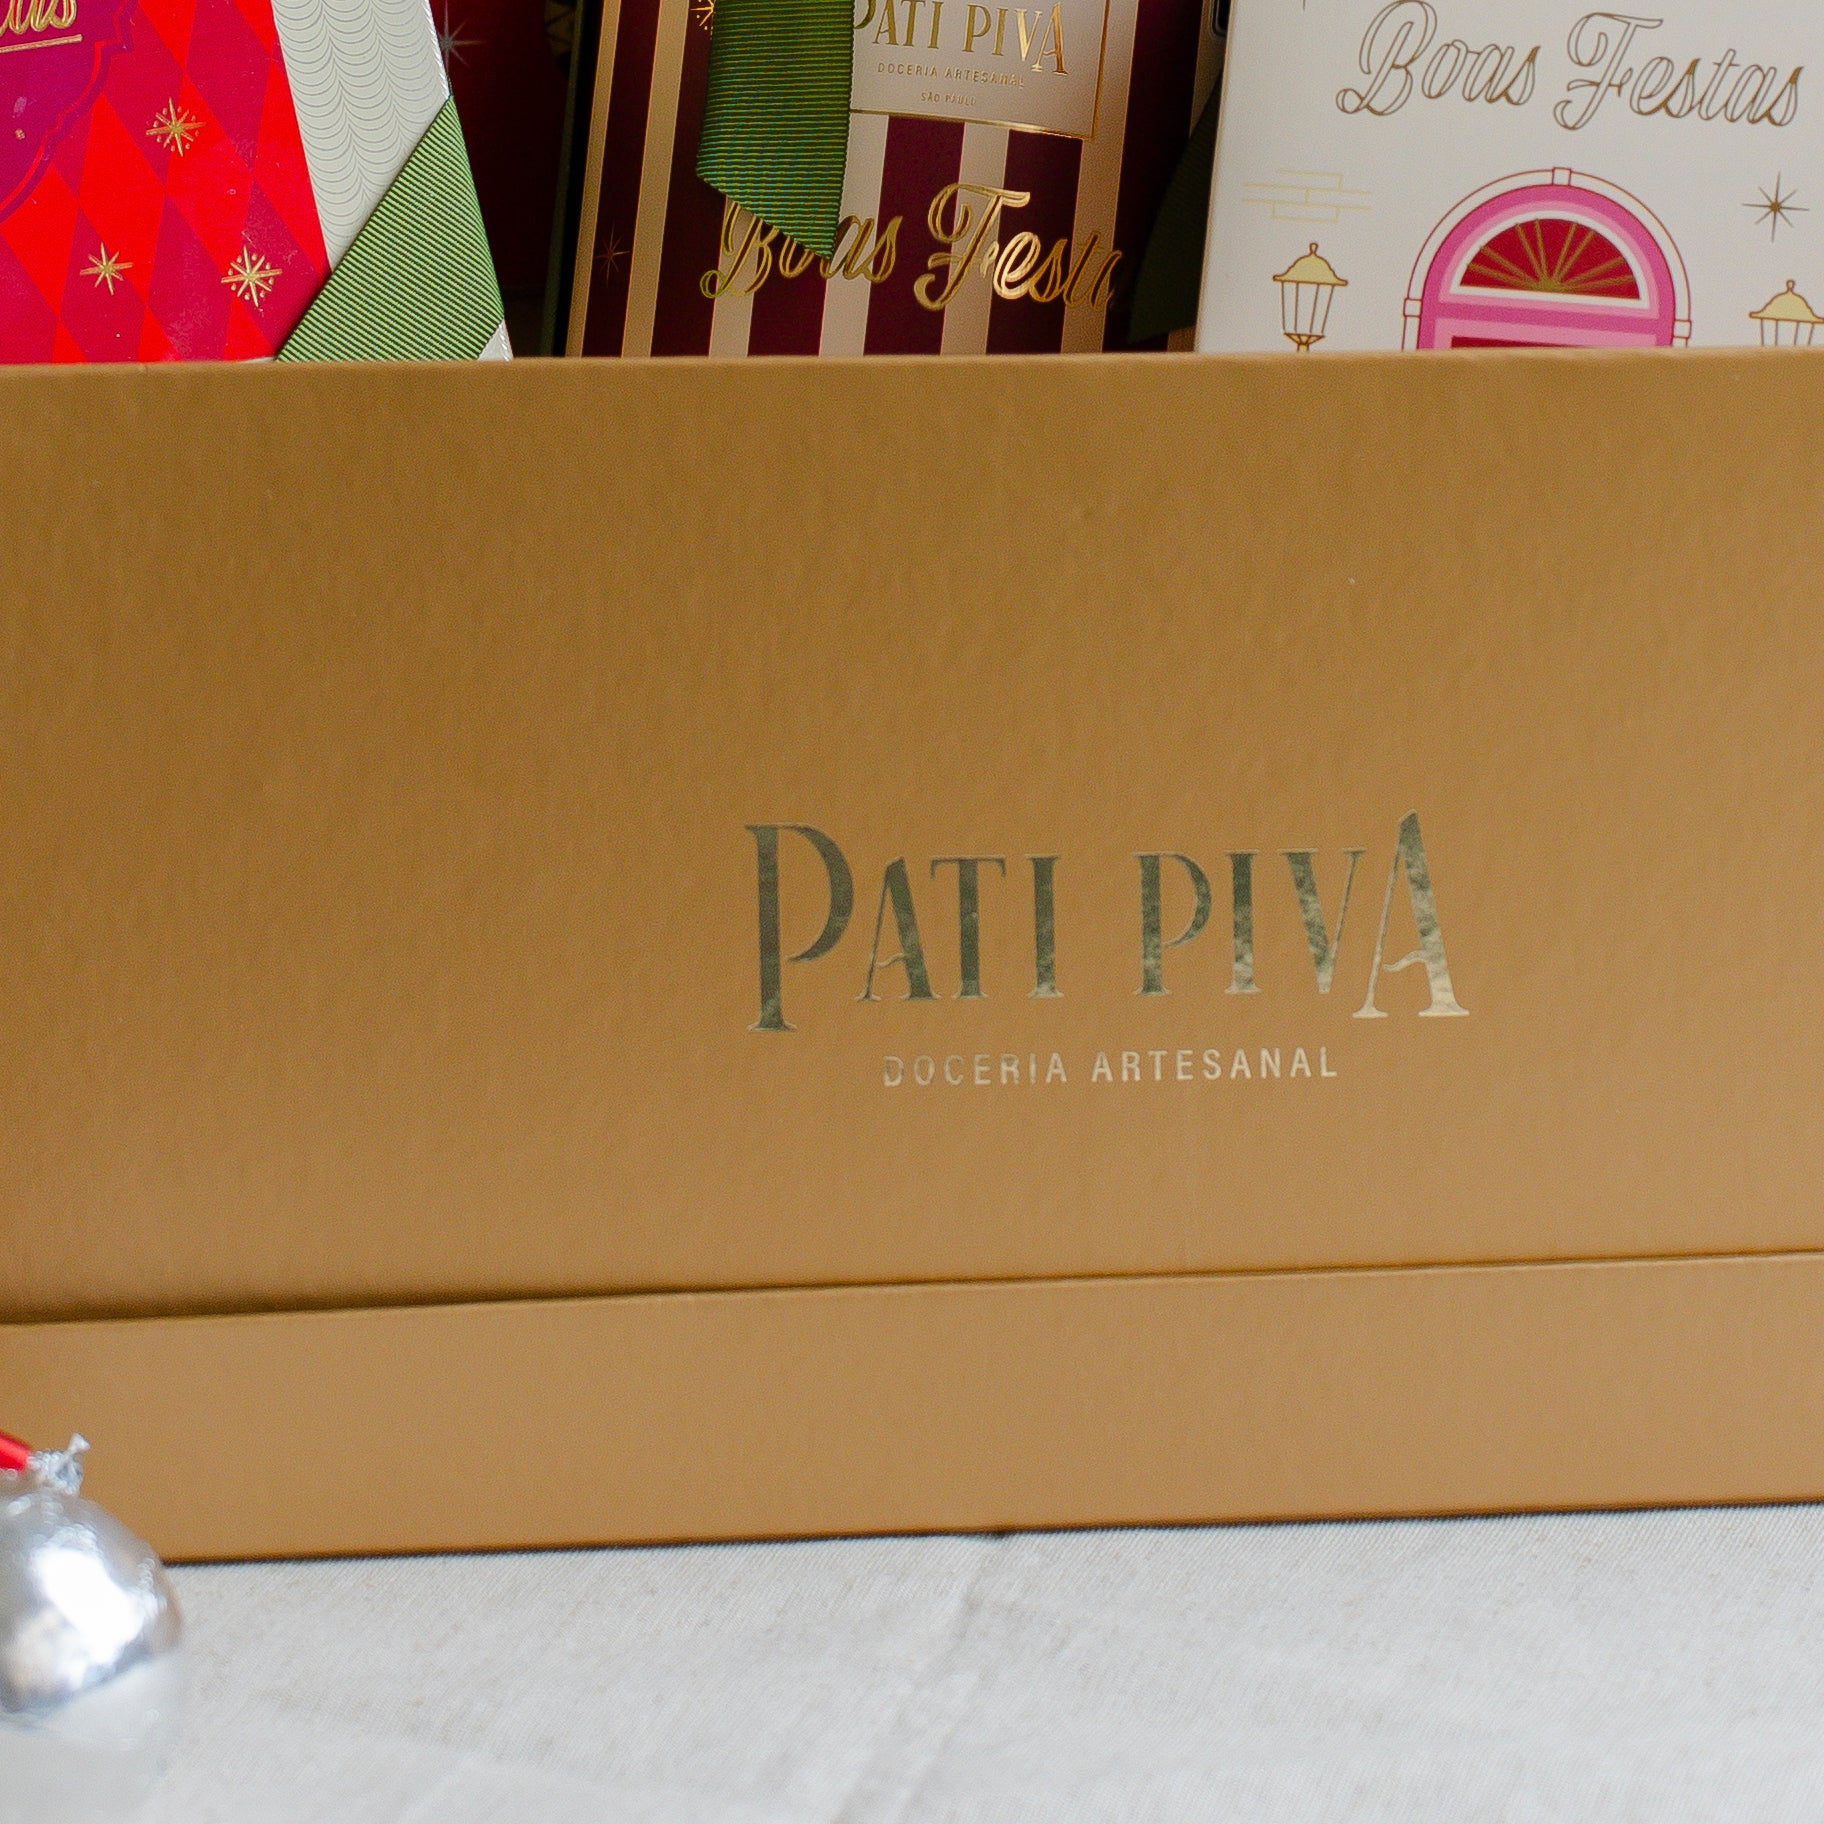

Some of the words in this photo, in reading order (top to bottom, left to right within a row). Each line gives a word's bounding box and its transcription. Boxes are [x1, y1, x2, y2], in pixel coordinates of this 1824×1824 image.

[962, 2, 1068, 75] PIVA
[877, 62, 938, 77] DOCERIA
[944, 69, 1025, 88] ARTESANAL
[920, 91, 940, 103] SÃO
[1553, 11, 1804, 131] Festas
[743, 822, 1066, 1032] PATI
[1133, 807, 1470, 1020] PIVA
[883, 1050, 1069, 1087] DOCERIA
[1090, 1045, 1339, 1084] ARTESANAL
